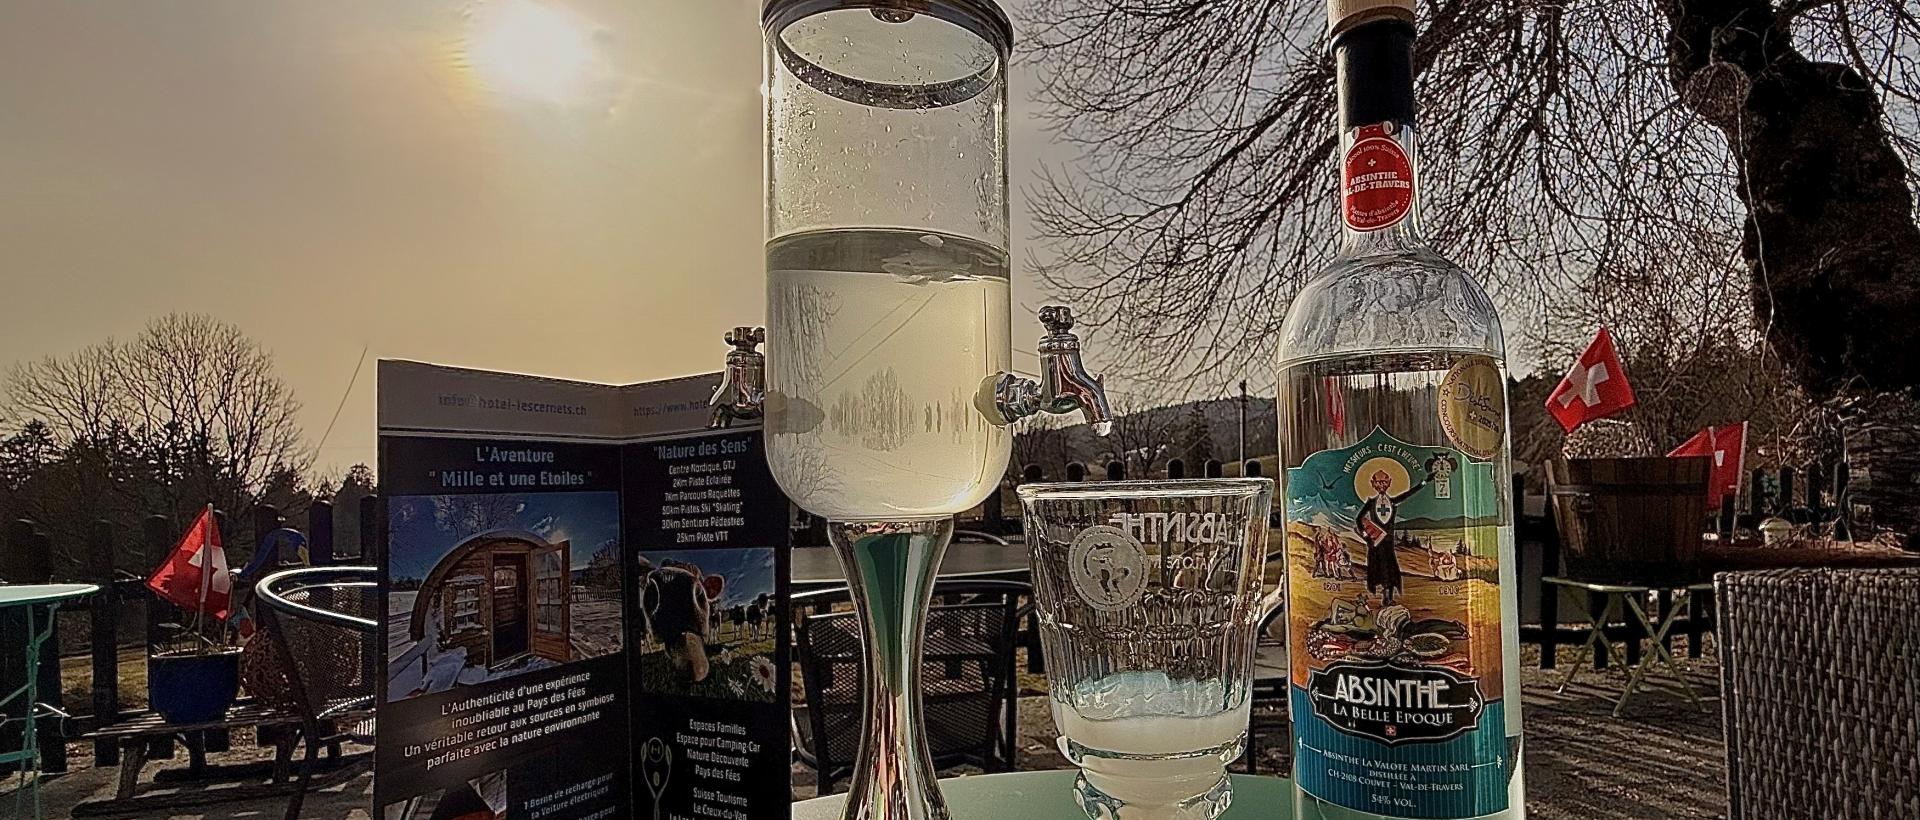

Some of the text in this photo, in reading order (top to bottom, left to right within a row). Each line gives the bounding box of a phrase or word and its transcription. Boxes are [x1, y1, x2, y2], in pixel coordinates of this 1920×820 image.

[1350, 171, 1398, 186] ABSINTHE
[476, 447, 555, 463] L'Aventure
[698, 441, 717, 456] des
[669, 460, 736, 475] Centre Nordique, GTJ
[442, 471, 484, 487] Mille
[489, 472, 505, 486] et
[509, 475, 536, 486] une
[540, 471, 584, 486] Etoiles
[688, 477, 705, 487] Piste
[679, 491, 707, 501] Parcours
[707, 488, 741, 501] Raquettes
[680, 504, 700, 515] Pistes
[701, 503, 711, 513] Ski
[661, 519, 680, 529] 30km
[710, 516, 745, 527] Pédestres
[676, 531, 729, 543] 25km Piste VTT
[441, 671, 591, 716] L'Authenticité d'une expérience
[1335, 673, 1450, 709] ABSINTHE
[452, 687, 586, 729] inoubliable au Pays des Fées
[404, 692, 615, 757] Un véritable retour aux sources en symbiose
[689, 718, 746, 736] Espaces Familles
[427, 710, 600, 770] parfaite avec la nature environnante
[676, 732, 699, 746] Espace
[700, 739, 716, 749] pour
[687, 748, 749, 768] Nature Découverte
[695, 765, 741, 782] Pays des Fées
[529, 794, 553, 808] Borne
[554, 790, 564, 800] de
[565, 778, 596, 795] recharge
[597, 772, 614, 785] pour
[693, 787, 748, 807] Suisse Tourisme
[1371, 793, 1391, 805] 54%
[541, 800, 569, 816] Voiture
[693, 802, 702, 815] Le
